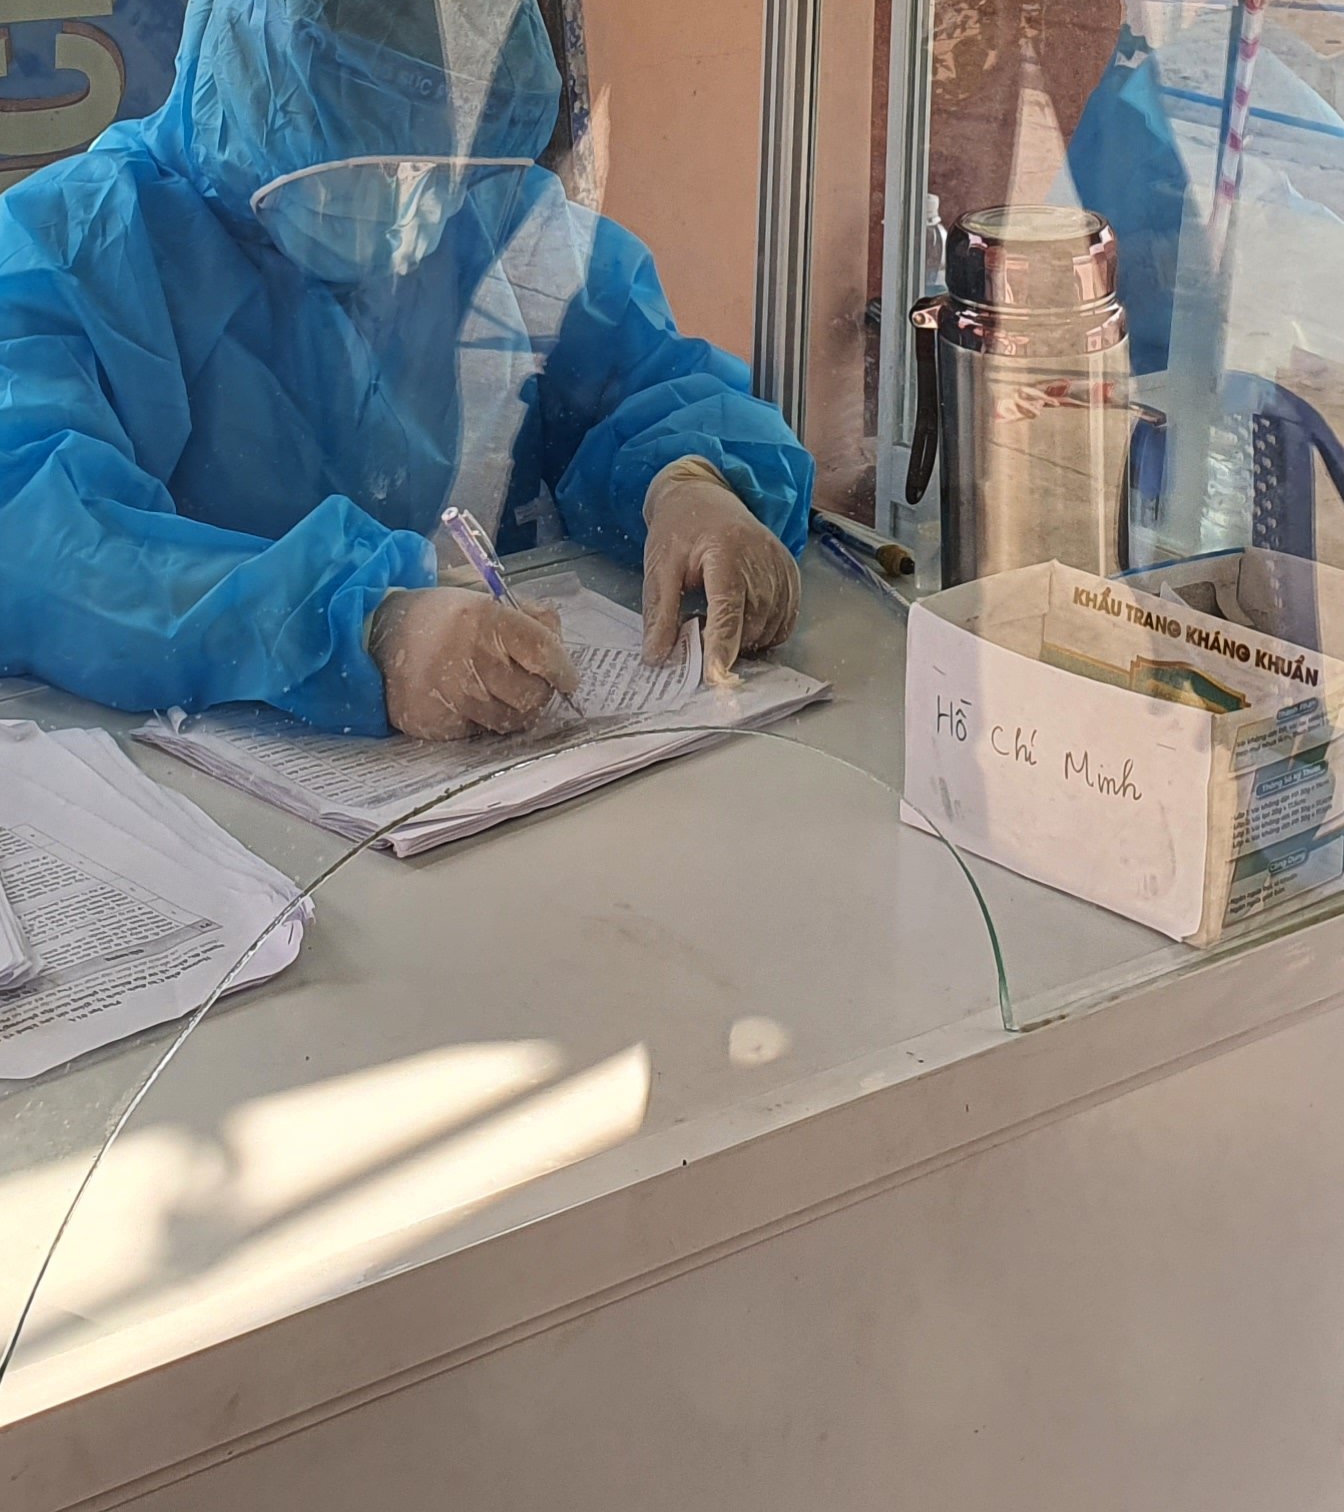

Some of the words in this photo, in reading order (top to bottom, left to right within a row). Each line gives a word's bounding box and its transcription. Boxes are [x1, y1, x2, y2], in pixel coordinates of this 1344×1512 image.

[1073, 586, 1122, 618] KHẨU
[1126, 603, 1181, 638] TRANG
[1186, 625, 1250, 663] KHÁNG
[1255, 649, 1318, 686] KHUẨN
[937, 695, 972, 741] Hồ
[992, 726, 1037, 765] Chí
[1065, 751, 1142, 800] Minh
